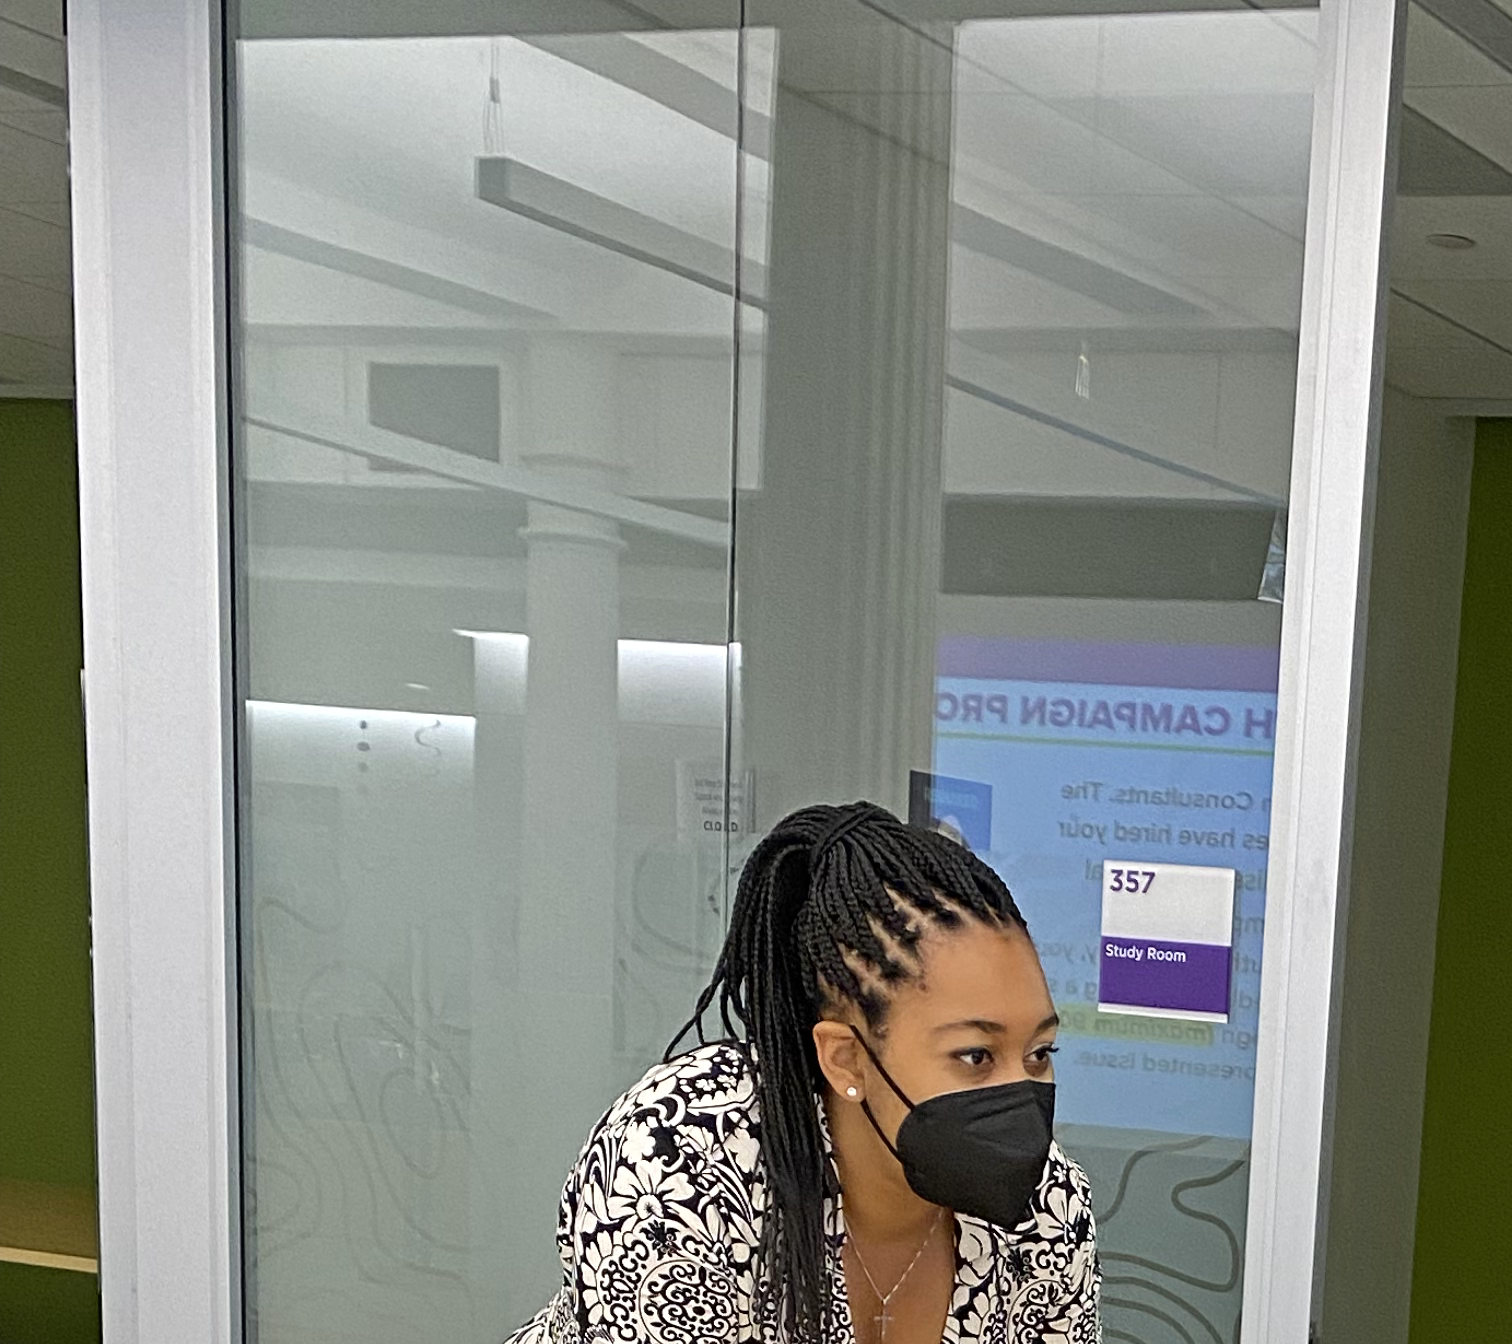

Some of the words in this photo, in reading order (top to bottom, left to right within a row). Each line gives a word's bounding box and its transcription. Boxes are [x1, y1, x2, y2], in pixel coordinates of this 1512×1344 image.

[1109, 869, 1156, 893] 357
[1105, 943, 1143, 962] Study
[1147, 946, 1187, 963] Room
